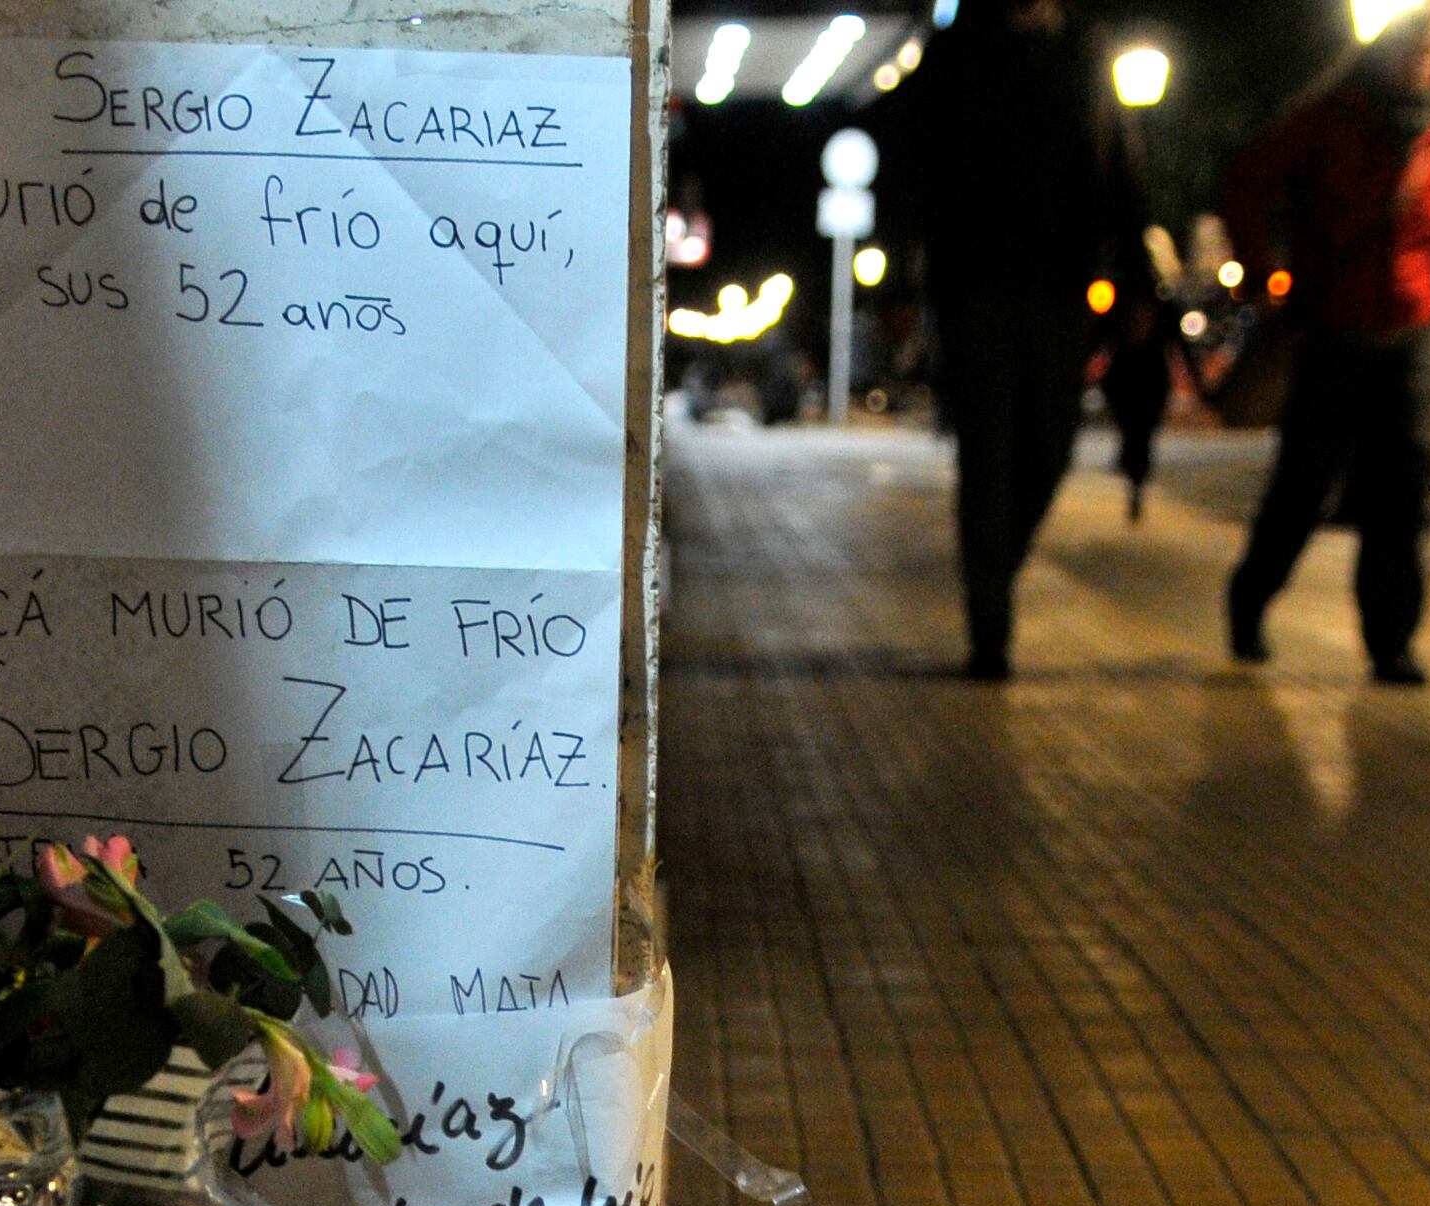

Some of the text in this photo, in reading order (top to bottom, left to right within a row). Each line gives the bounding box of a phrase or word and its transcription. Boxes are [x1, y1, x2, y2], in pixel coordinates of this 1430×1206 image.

[53, 51, 568, 149] SERGIO ZACARIAZ
[140, 179, 200, 234] de
[260, 174, 382, 252] frío
[429, 209, 576, 286] aquí,
[37, 268, 130, 311] sus
[175, 260, 265, 328] 52
[111, 578, 293, 644] MURIÓ
[342, 593, 412, 650] DE
[451, 594, 587, 659] FRÍO
[225, 848, 287, 891] 52
